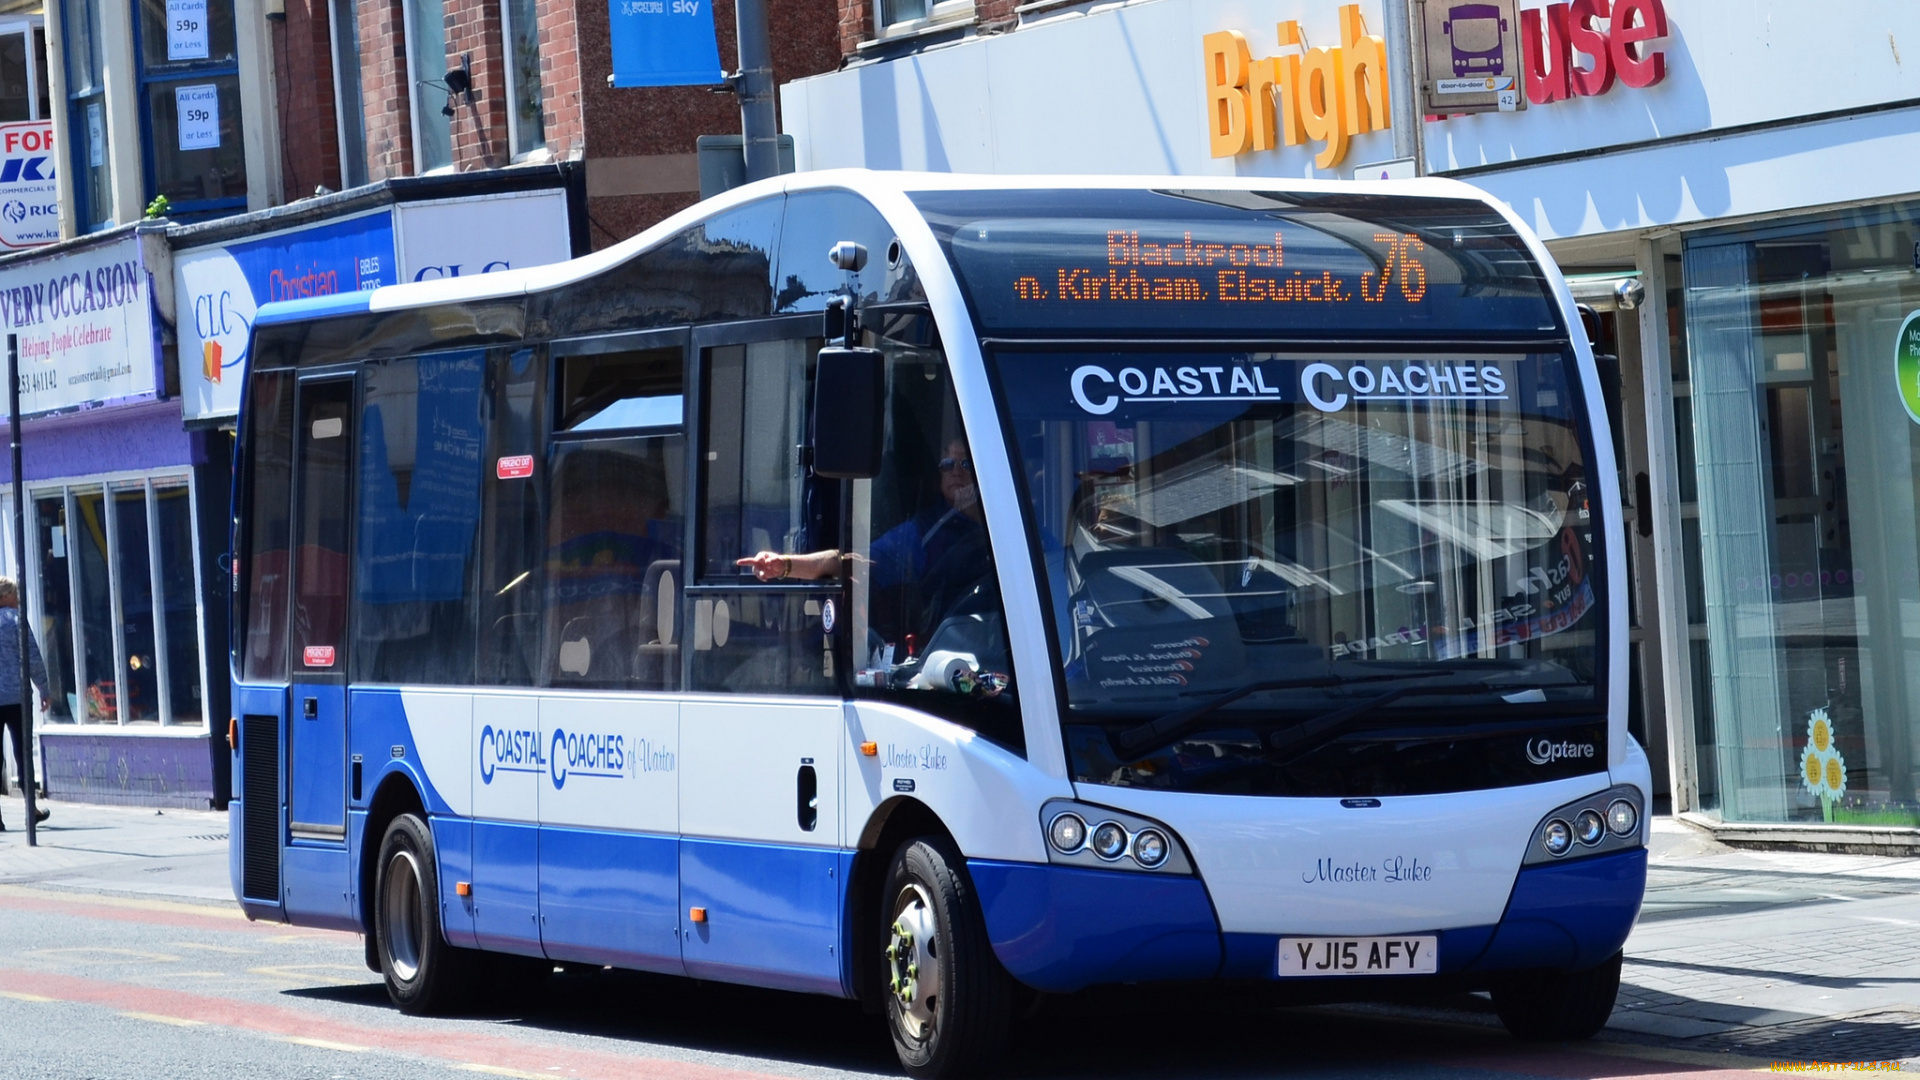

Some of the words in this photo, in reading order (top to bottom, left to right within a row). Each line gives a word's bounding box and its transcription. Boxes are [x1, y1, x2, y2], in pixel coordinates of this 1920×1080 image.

[169, 3, 180, 11] All
[182, 2, 205, 10] Cards
[672, 0, 699, 16] sky
[176, 19, 198, 32] 59p
[185, 40, 202, 48] Less
[179, 93, 190, 101] All
[192, 91, 215, 100] Cards
[1202, 3, 1391, 170] Brigh
[1501, 95, 1513, 105] 42
[187, 109, 209, 122] 59p
[186, 132, 195, 140] or
[197, 130, 212, 139] Less
[16, 229, 59, 240] www.ka
[1107, 231, 1284, 268] Blackpool
[360, 256, 380, 275] BIBLES
[1373, 233, 1426, 302] 76
[0, 283, 44, 329] VERY
[48, 260, 138, 320] OCCASION
[270, 260, 339, 302] Christian
[1058, 269, 1209, 300] Kirkham,
[1218, 270, 1351, 302] Elswick,
[195, 290, 232, 339] CLC
[21, 336, 50, 360] Helping
[52, 325, 72, 356] People
[73, 322, 112, 347] Celebrate
[32, 369, 57, 392] 461142
[1070, 365, 1280, 416] COASTAL
[1301, 362, 1508, 413] COACHES
[479, 724, 547, 786] COASTAL
[551, 728, 624, 790] COACHES
[627, 737, 637, 779] of
[638, 738, 675, 773] Warton
[882, 744, 917, 769] Master
[920, 744, 947, 771] Luke
[1536, 738, 1594, 763] Optare
[1302, 858, 1376, 884] Master
[1383, 856, 1432, 883] Luke
[1297, 942, 1358, 970] YJ15
[1367, 941, 1420, 970] AFY
